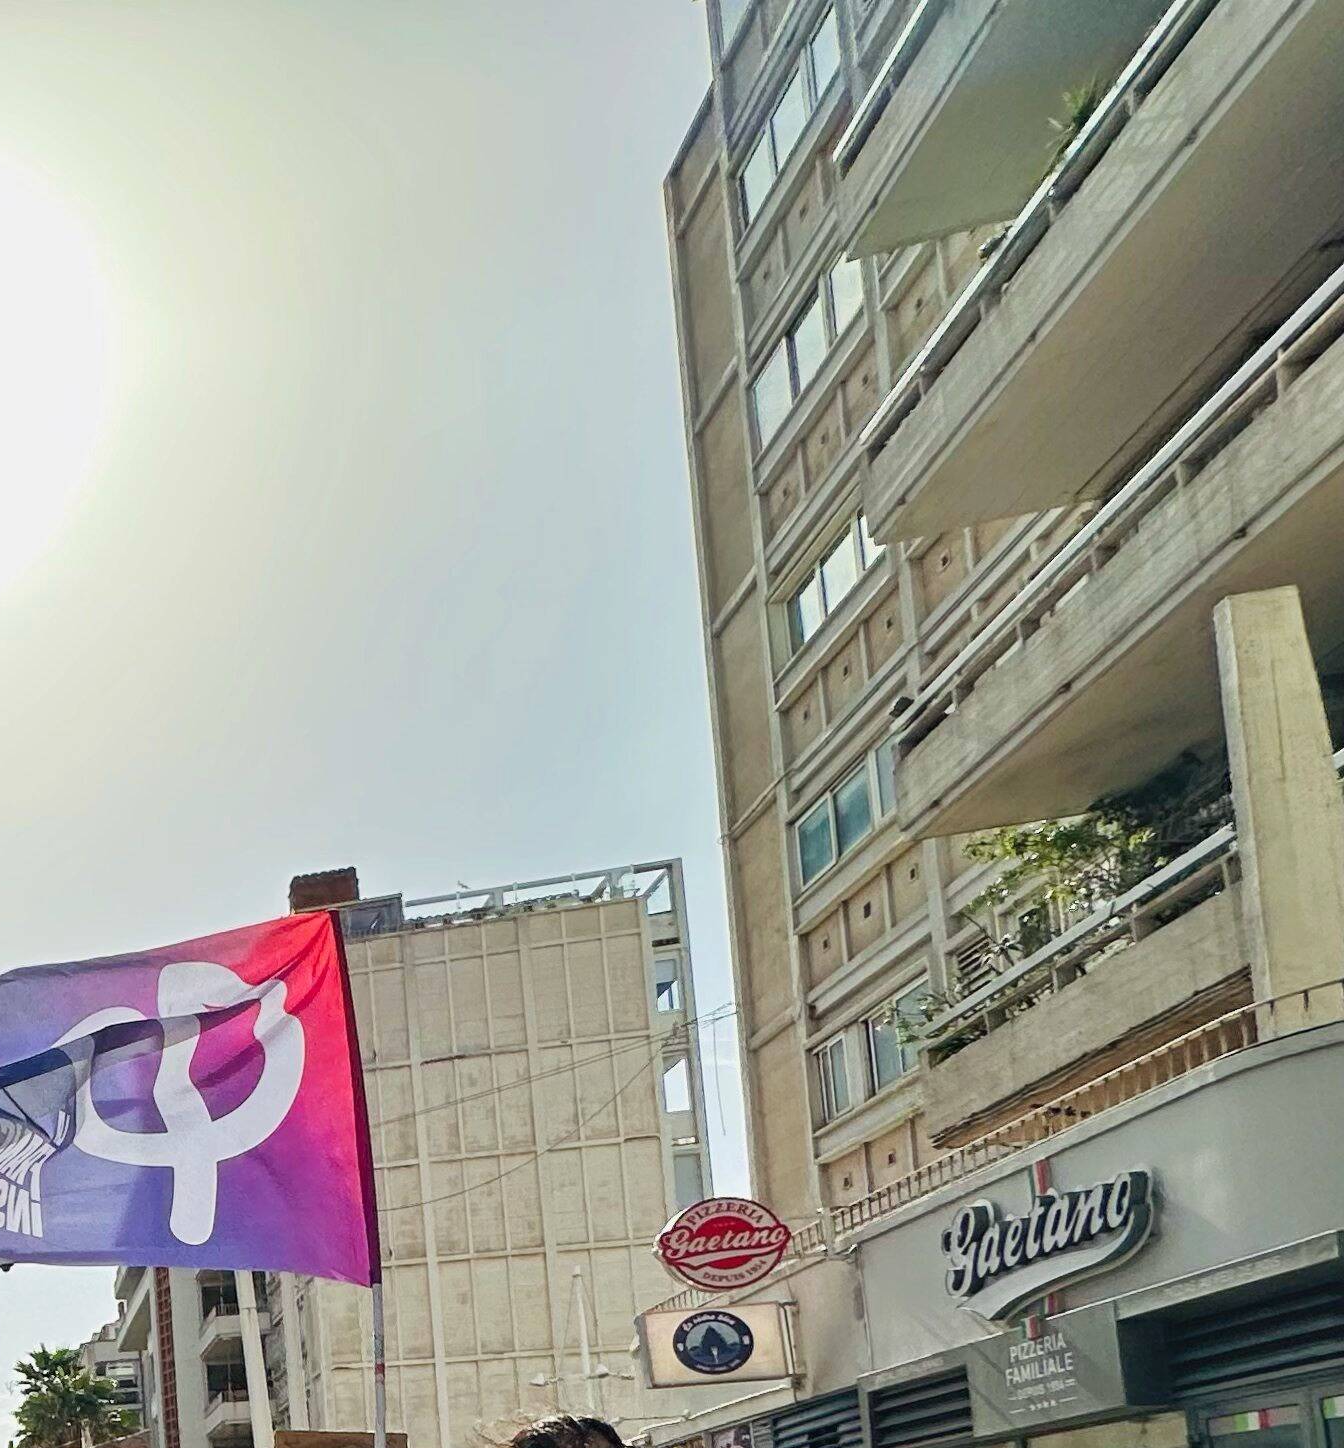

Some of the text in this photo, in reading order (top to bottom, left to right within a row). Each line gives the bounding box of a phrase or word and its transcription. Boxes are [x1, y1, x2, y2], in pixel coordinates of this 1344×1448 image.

[685, 1202, 763, 1226] PIZZERIA
[663, 1226, 786, 1260] Gaetano
[942, 1165, 1150, 1298] Gaetano
[703, 1269, 746, 1282] DEPUIS
[1009, 1333, 1067, 1362] PIZZERIA
[1005, 1352, 1074, 1386] FAMILIALE
